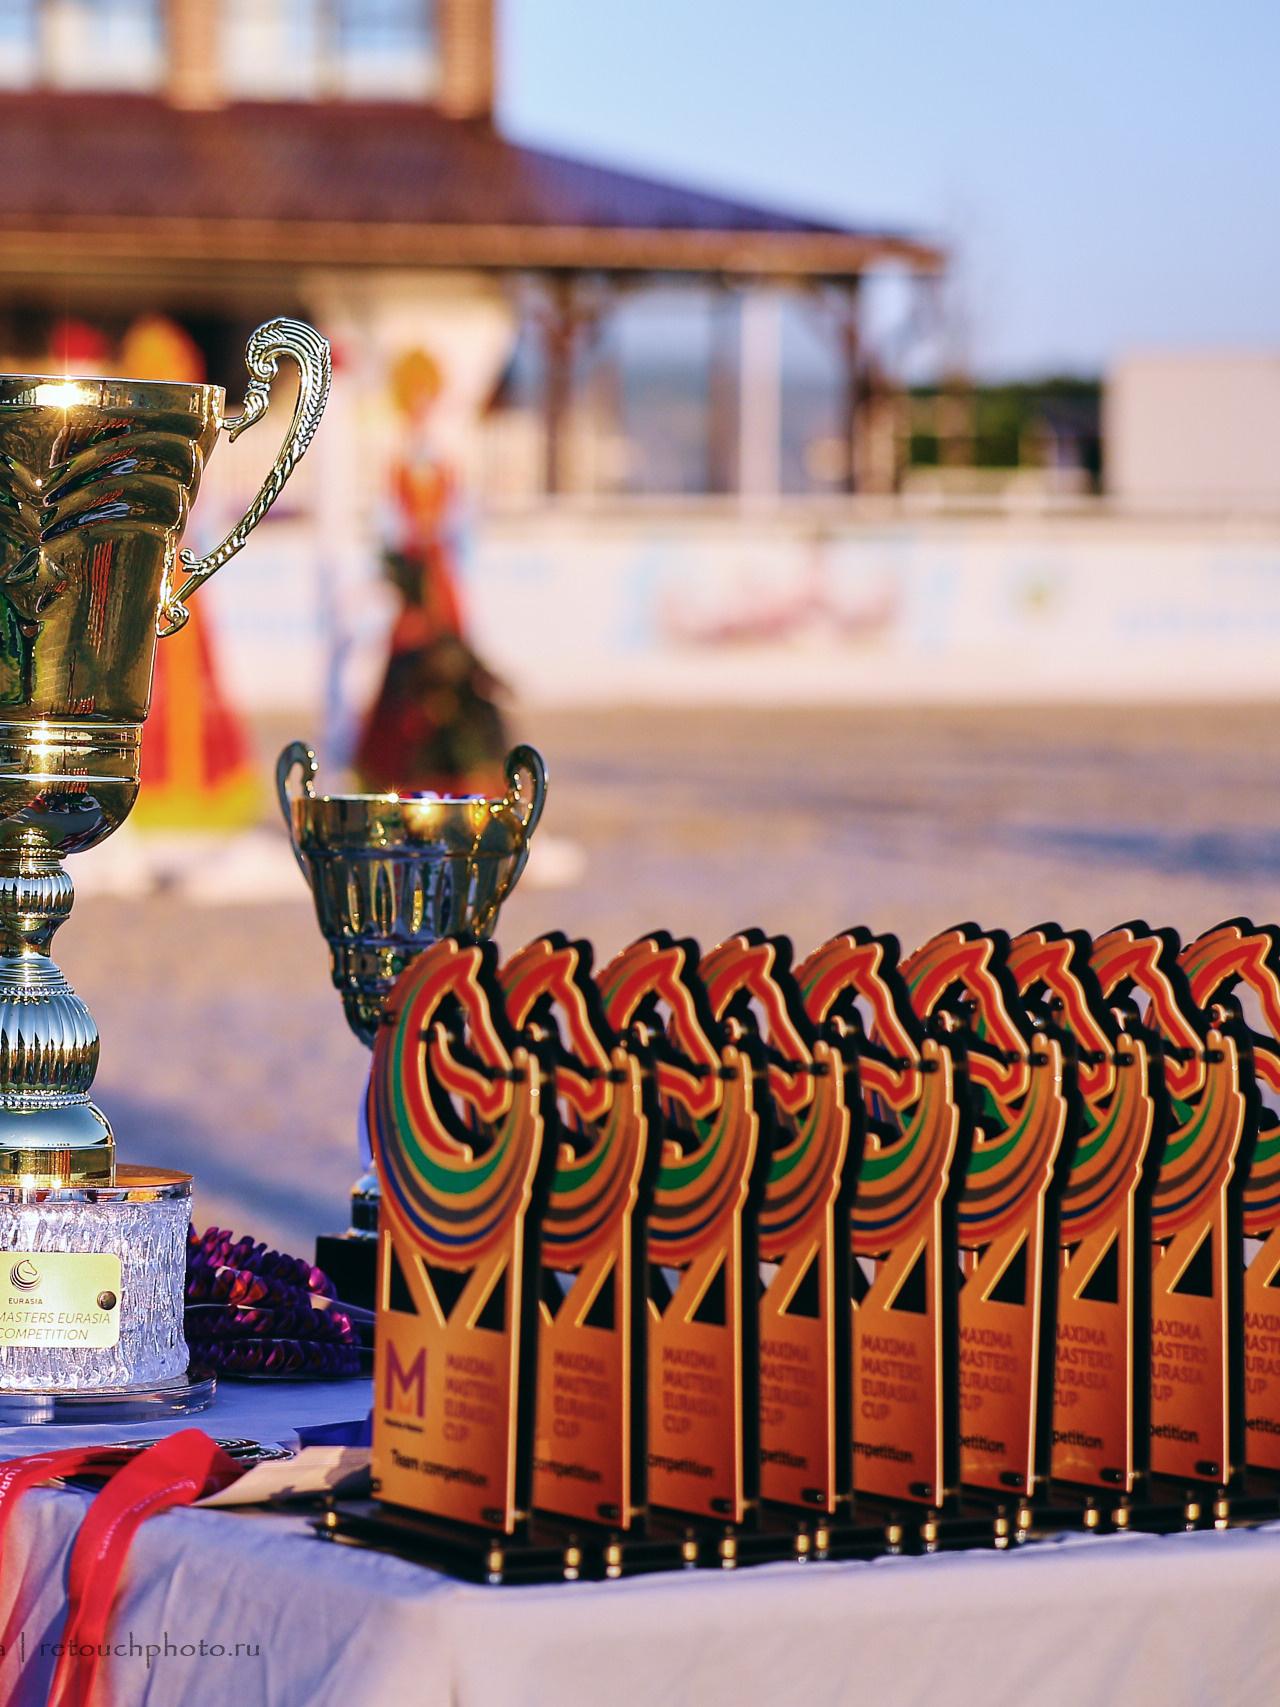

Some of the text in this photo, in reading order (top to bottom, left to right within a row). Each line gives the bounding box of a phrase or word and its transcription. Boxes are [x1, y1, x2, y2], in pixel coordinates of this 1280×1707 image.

[8, 1297, 43, 1305] EURASIA
[57, 1312, 111, 1324] EURASIA
[1151, 1318, 1203, 1342] AXIMA
[861, 1333, 917, 1358] MAXIMA
[1151, 1340, 1208, 1364] ASTERS
[384, 1338, 427, 1418] M
[861, 1356, 922, 1383] MASTERS
[1055, 1366, 1109, 1391] URASIA
[1151, 1361, 1203, 1386] URASIA
[861, 1377, 919, 1404] EURASIA
[1151, 1383, 1174, 1402] UP
[1246, 1376, 1267, 1395] UP
[861, 1400, 891, 1421] CUP
[662, 1413, 691, 1434] CUP
[391, 1448, 419, 1471] Team
[648, 1453, 716, 1479] ompetition
